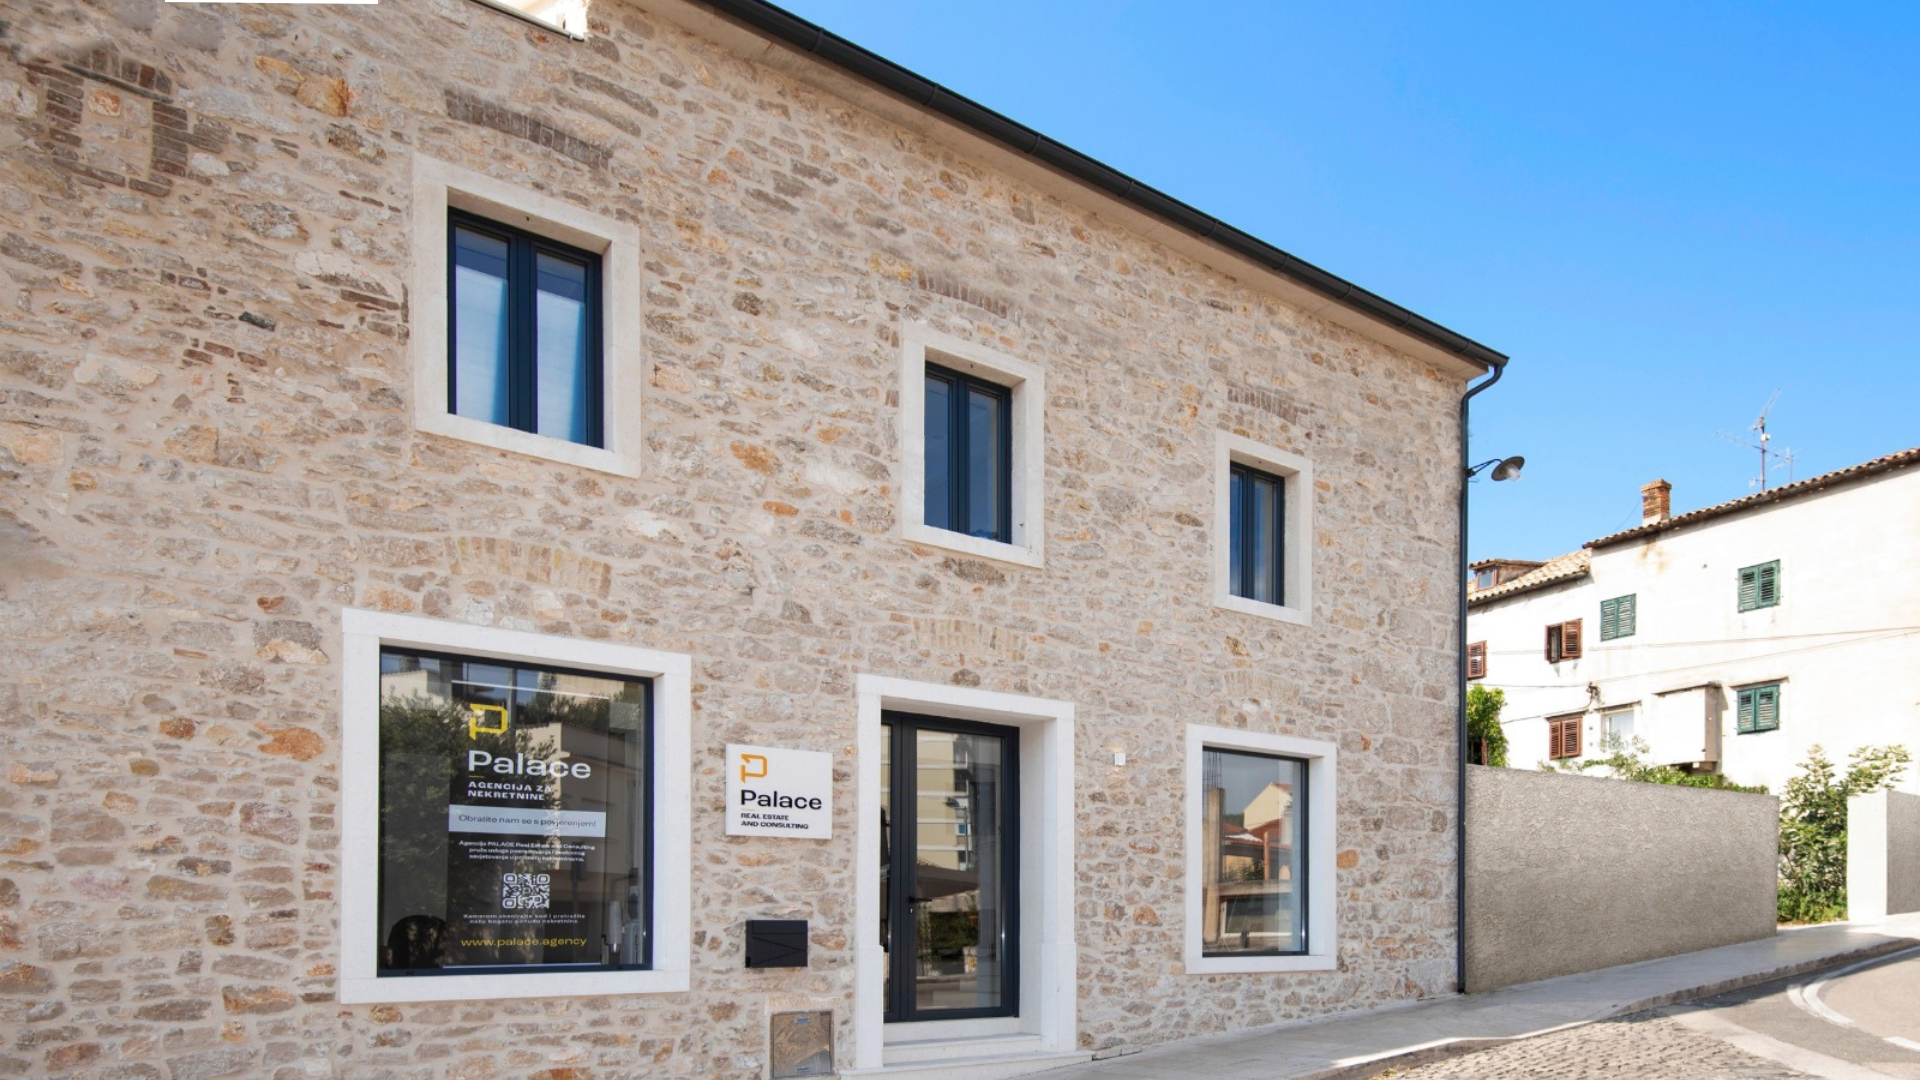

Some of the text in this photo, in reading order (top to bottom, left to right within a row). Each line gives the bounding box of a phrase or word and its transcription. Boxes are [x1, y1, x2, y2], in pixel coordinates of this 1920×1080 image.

[468, 750, 591, 779] Palace
[468, 781, 532, 791] AGENCIJA
[468, 790, 545, 800] NEKRETNINE
[741, 789, 822, 810] Palace
[459, 814, 498, 824] Obratite
[760, 821, 809, 829] CONSULTING
[461, 937, 588, 947] www.palace.agency
